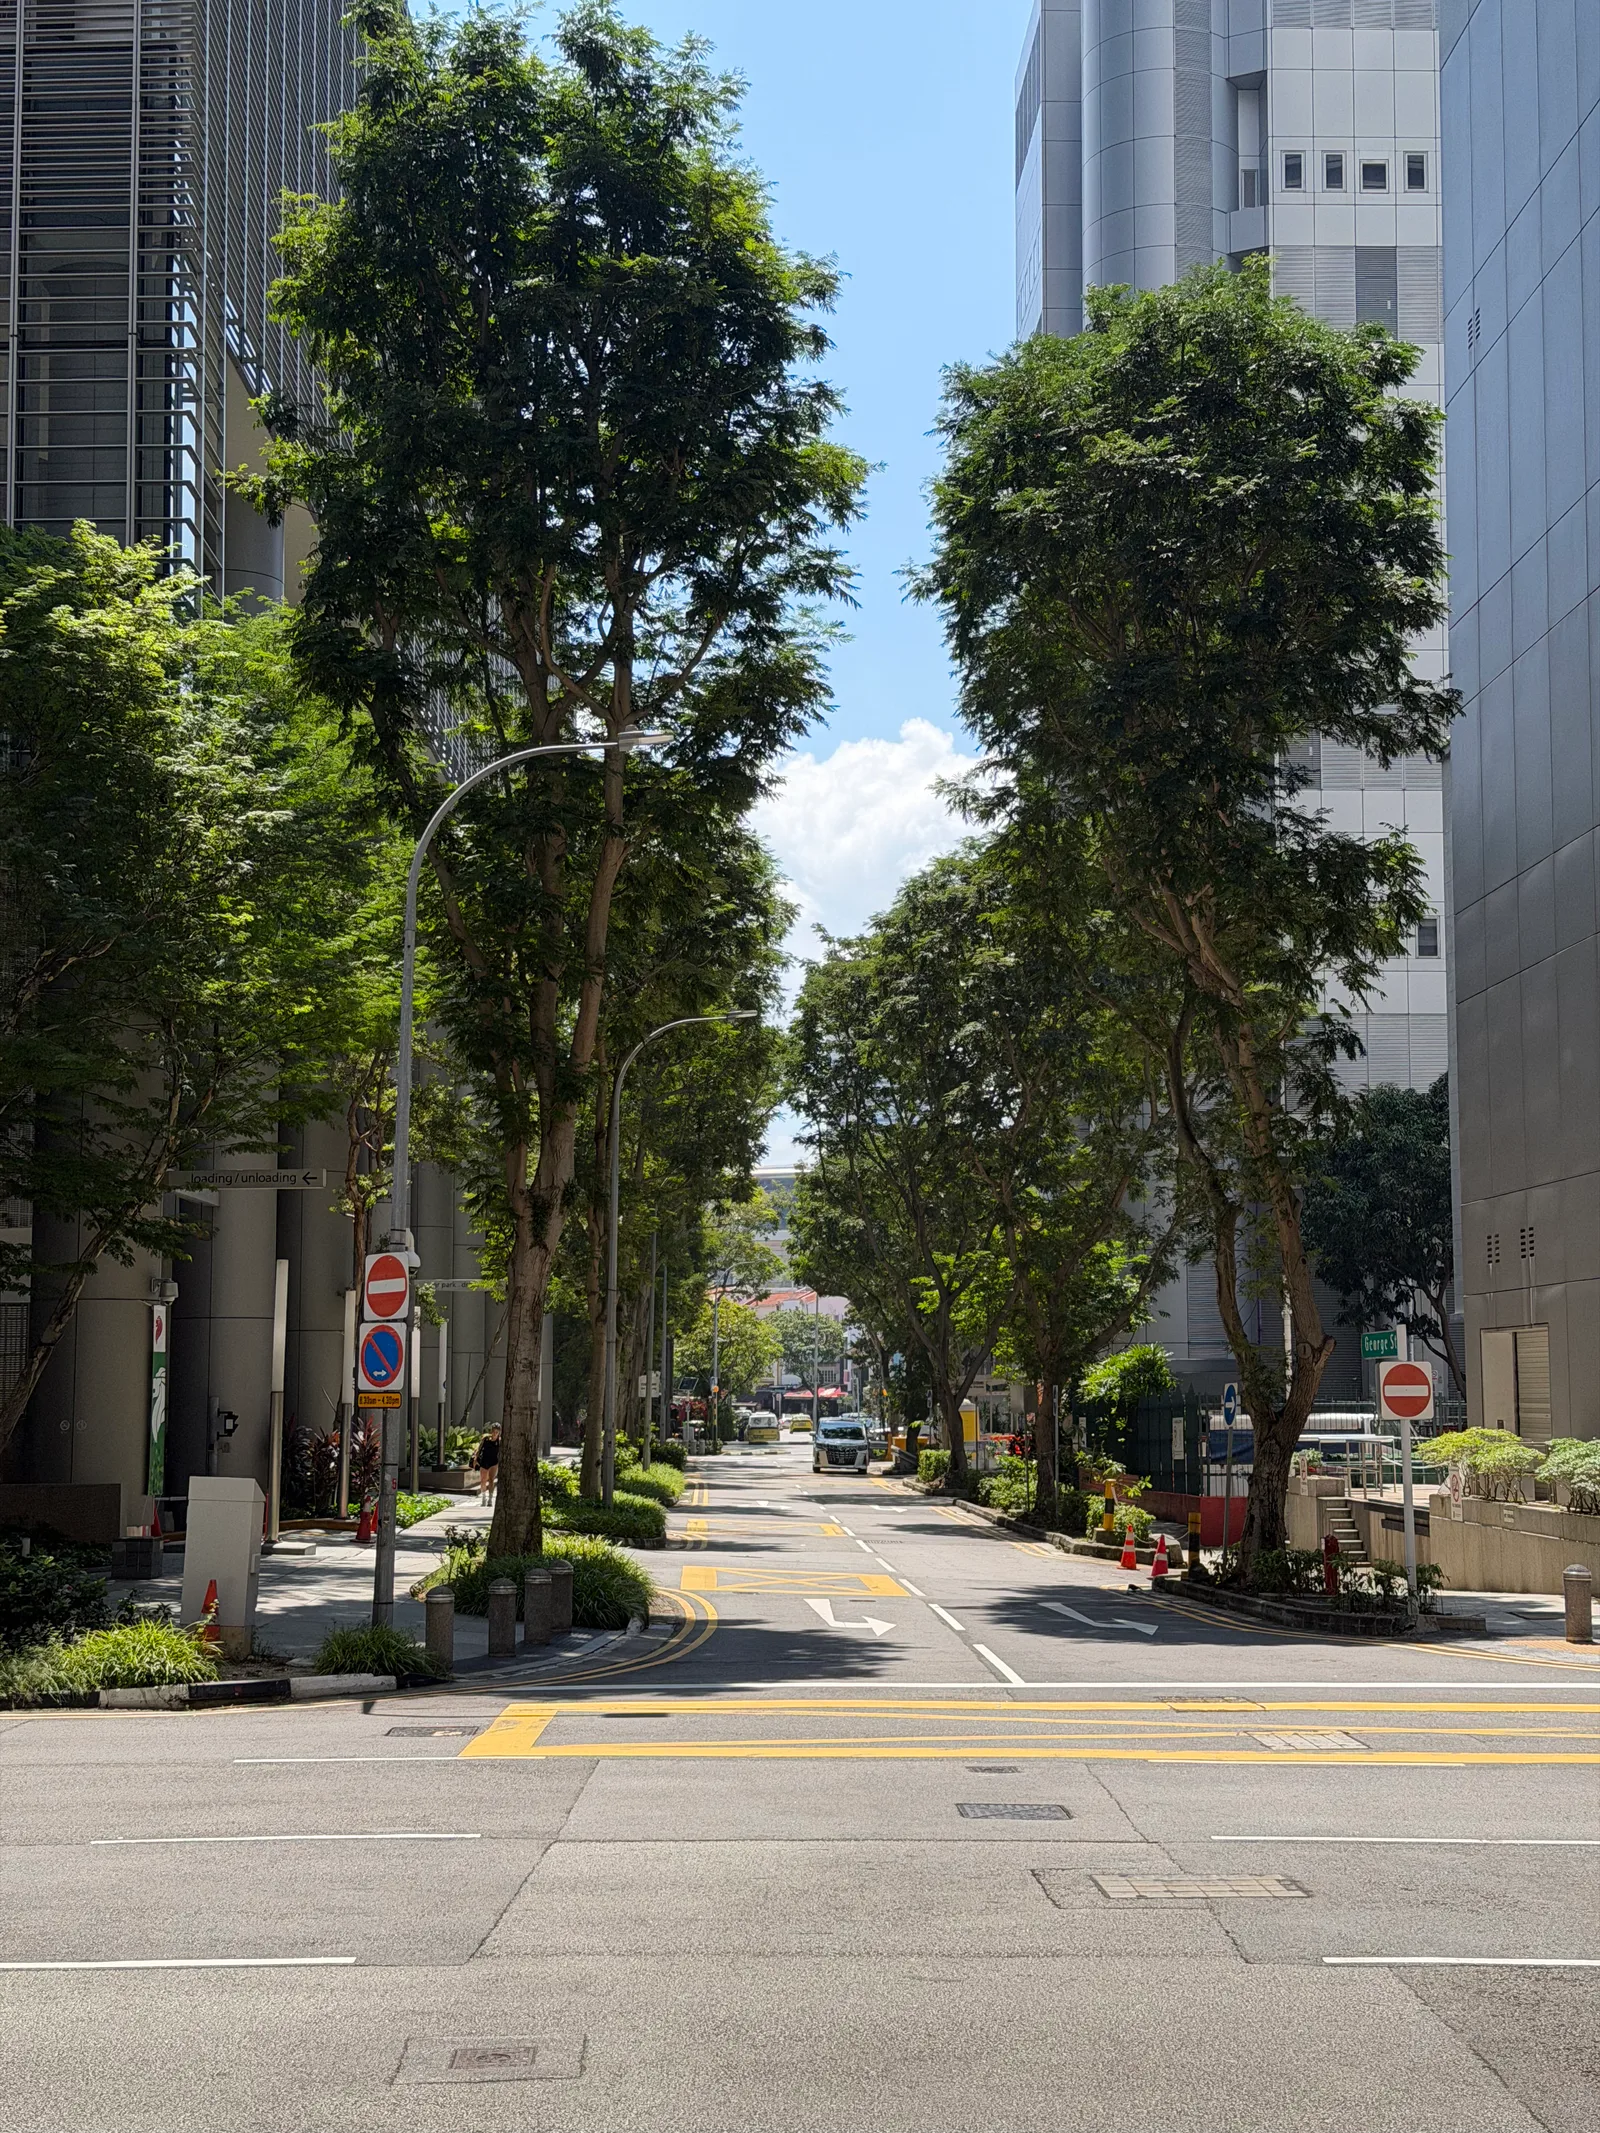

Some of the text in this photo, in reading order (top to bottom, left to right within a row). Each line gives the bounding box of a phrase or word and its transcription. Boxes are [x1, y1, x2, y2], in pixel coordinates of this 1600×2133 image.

[191, 1173, 232, 1185] loading
[241, 1172, 297, 1185] unloading
[1364, 1335, 1388, 1355] George
